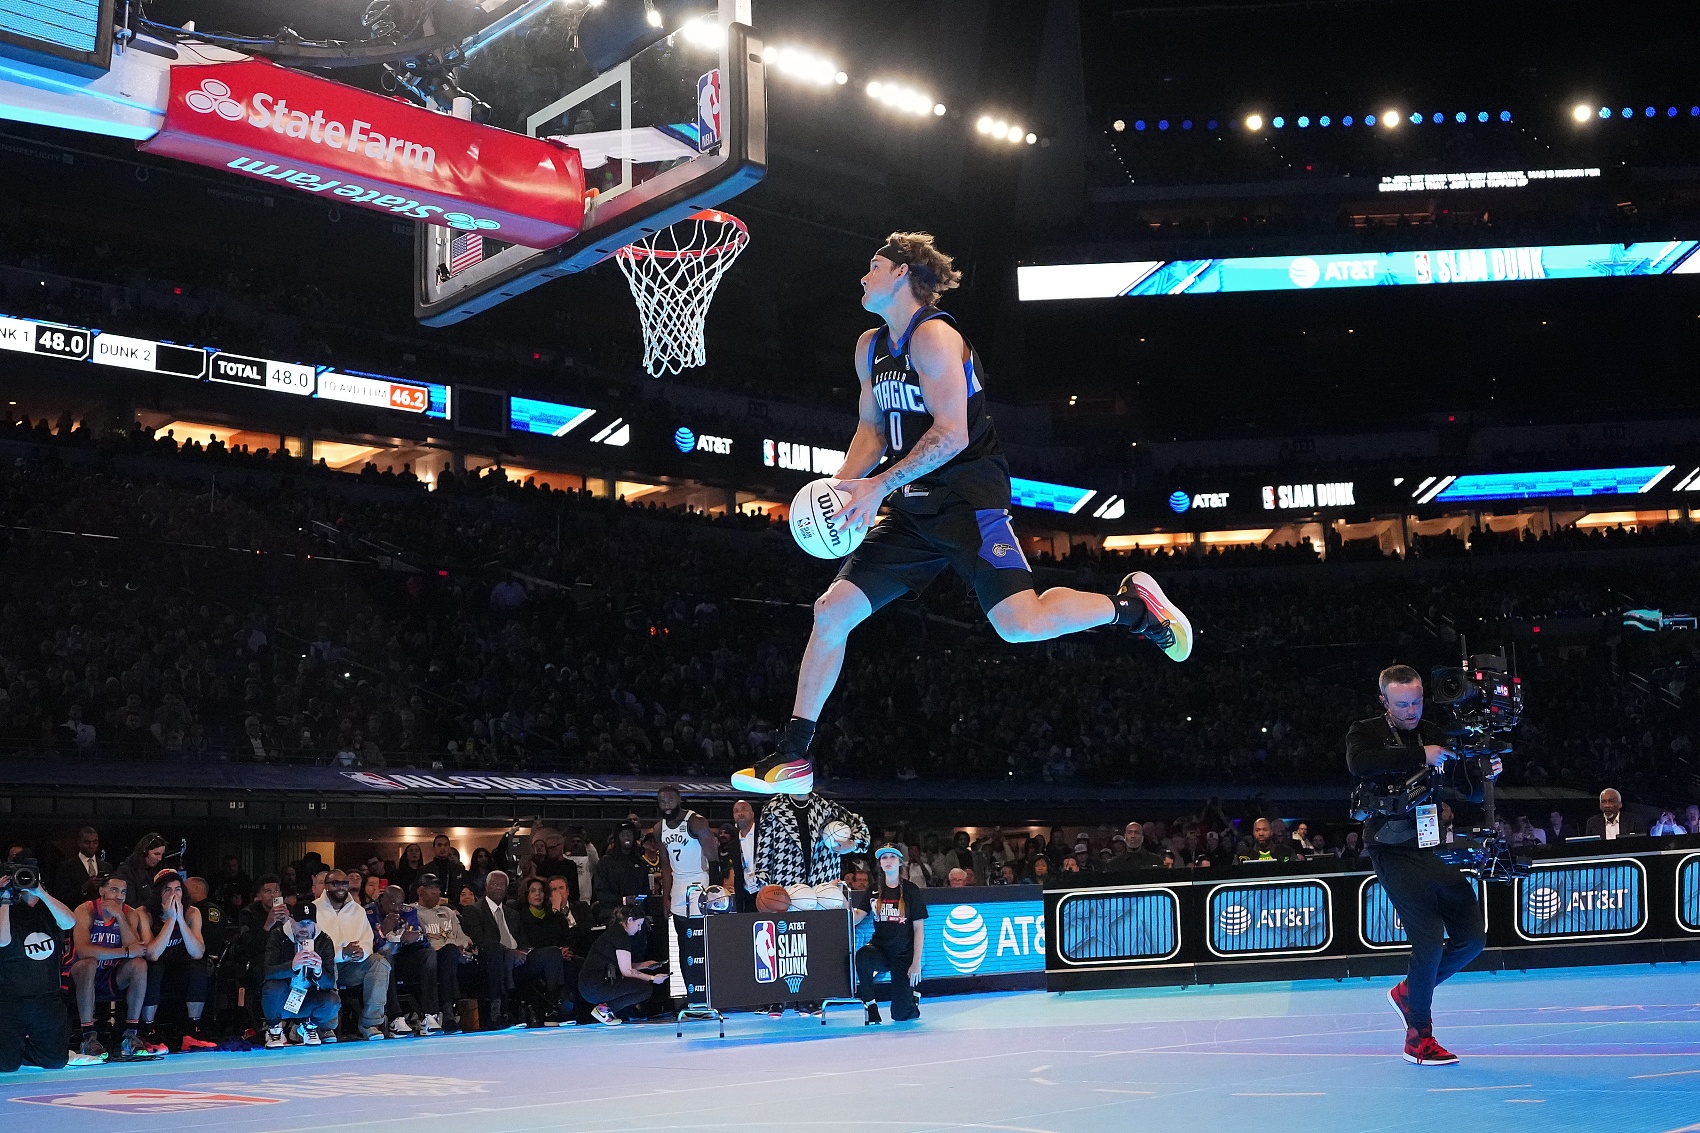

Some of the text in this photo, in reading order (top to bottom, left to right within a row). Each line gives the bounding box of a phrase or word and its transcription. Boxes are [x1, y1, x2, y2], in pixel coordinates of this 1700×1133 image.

[1324, 248, 1546, 282] AT&T SLAM DUNK
[38, 330, 84, 354] 48.0
[100, 343, 151, 361] DUNK 2
[217, 360, 309, 388] TOTAL 48.0
[391, 390, 424, 408] 46.2
[889, 411, 903, 451] 0
[696, 434, 733, 455] AT&T
[778, 441, 811, 472] SLAM
[1192, 482, 1356, 509] AT&T SLAM DUNK
[672, 848, 682, 862] 7
[1566, 888, 1629, 911] AT&T
[788, 922, 806, 931] AT&T
[1257, 907, 1315, 928] AT&T
[24, 938, 54, 955] TNT
[778, 934, 807, 957] SLAM
[758, 968, 769, 979] NBA
[779, 957, 808, 977] DUNK
